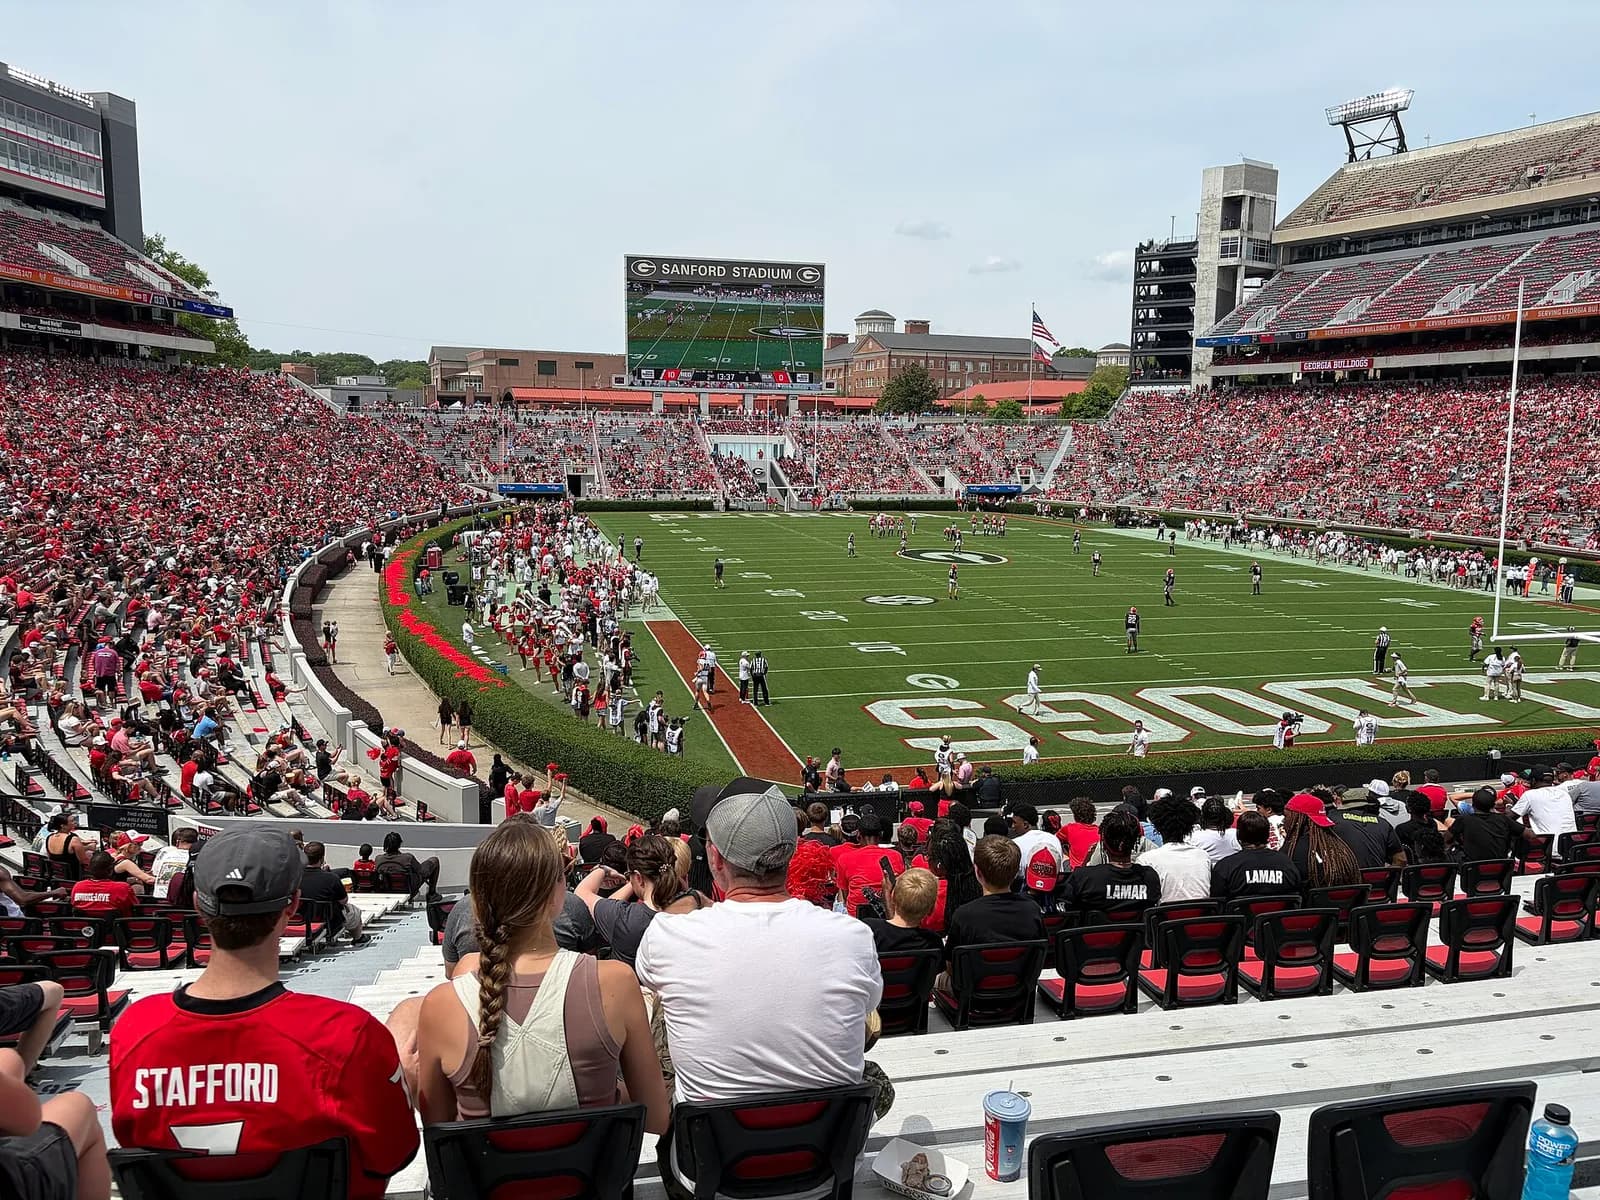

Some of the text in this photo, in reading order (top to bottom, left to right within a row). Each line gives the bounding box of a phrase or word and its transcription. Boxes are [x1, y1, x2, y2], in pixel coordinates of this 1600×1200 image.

[661, 263, 792, 280] SANFORD STADIUM
[1537, 308, 1561, 318] SERVING
[1562, 306, 1586, 316] GEORGIA
[1425, 319, 1446, 328] SERVING
[1303, 358, 1369, 371] GEORGIA BULLDOGS
[717, 373, 735, 381] 13:37
[1127, 616, 1137, 624] 22
[1245, 869, 1283, 885] LAMAR
[1105, 884, 1148, 900] LAMAR
[132, 1062, 279, 1109] STAFFORD
